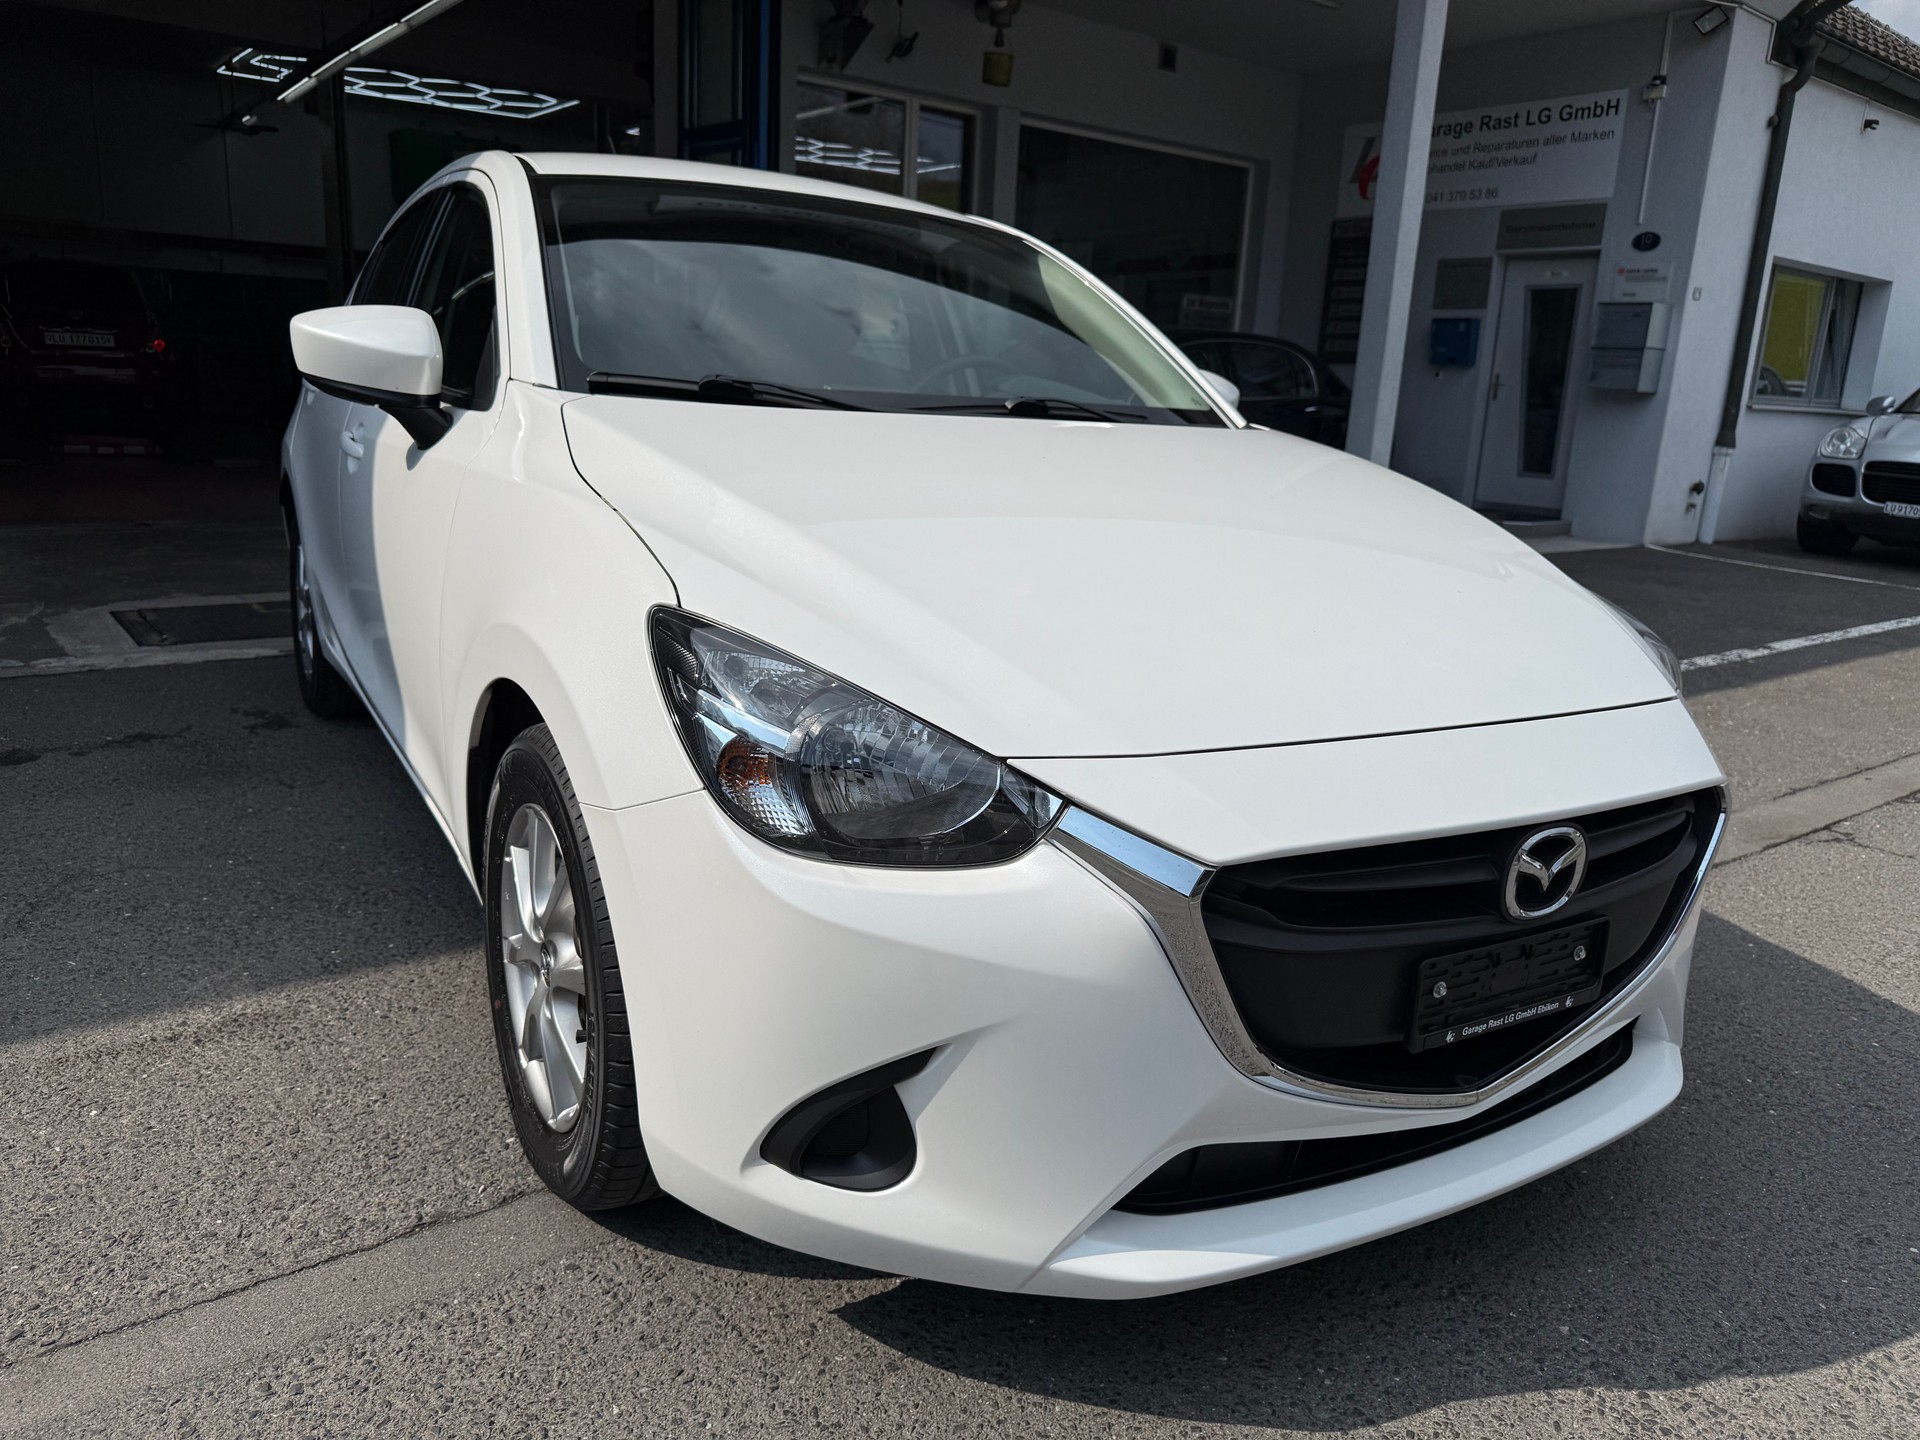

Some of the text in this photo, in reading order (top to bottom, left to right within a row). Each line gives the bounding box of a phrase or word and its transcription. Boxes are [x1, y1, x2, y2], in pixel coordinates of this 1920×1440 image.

[1479, 112, 1520, 132] Rast
[1525, 107, 1553, 126] LG
[1559, 98, 1621, 122] GmbH
[1451, 144, 1470, 156] und
[1473, 137, 1540, 154] Reparaturen
[1542, 132, 1567, 146] aller
[1570, 128, 1615, 143] Marken
[1468, 153, 1539, 170] Kauf/Verkauf
[1426, 190, 1444, 204] 041
[1449, 189, 1466, 202] 370
[1469, 188, 1483, 201] 53
[1641, 234, 1654, 246] 10
[52, 334, 66, 343] LU
[1462, 1001, 1559, 1036] Garage Rast LG GmbH Ebikon
